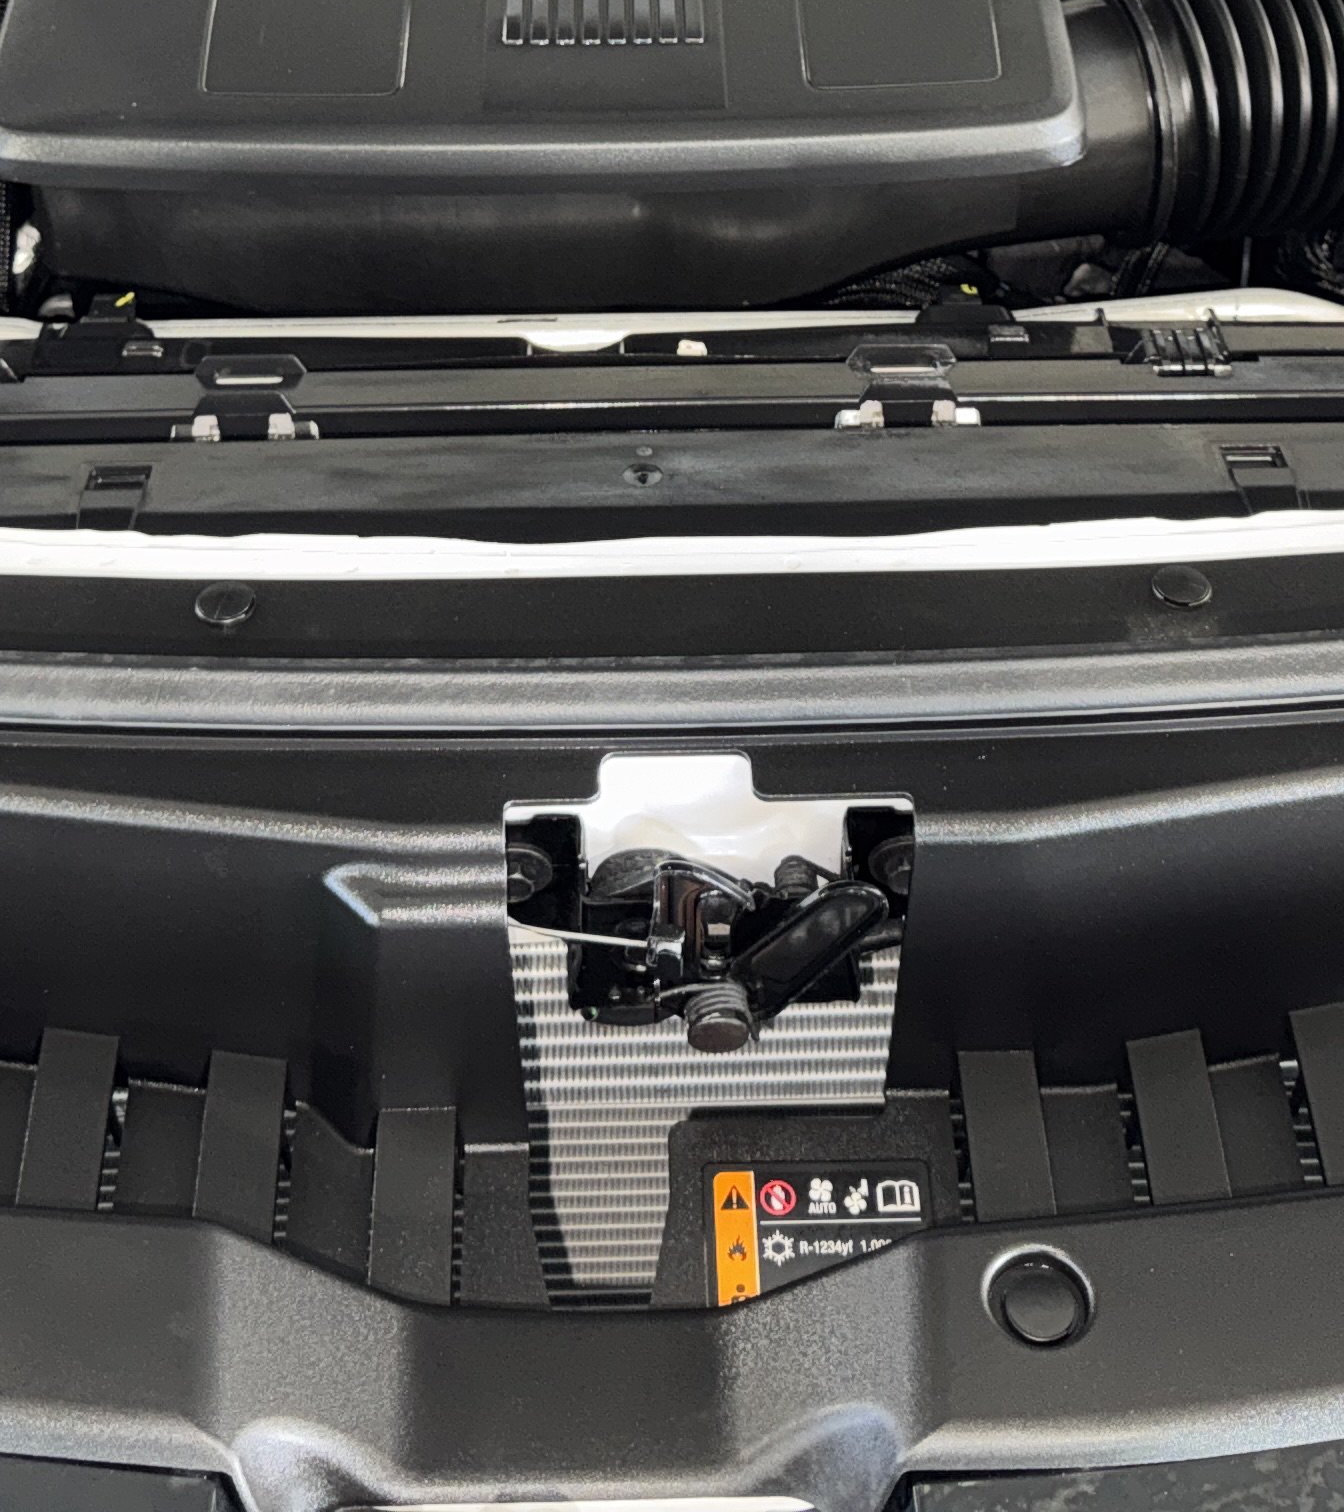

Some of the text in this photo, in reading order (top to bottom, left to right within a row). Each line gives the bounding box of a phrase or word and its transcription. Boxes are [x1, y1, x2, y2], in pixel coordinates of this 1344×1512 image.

[807, 1201, 837, 1214] AUTO
[799, 1239, 892, 1256] R-1234yf 1.00
